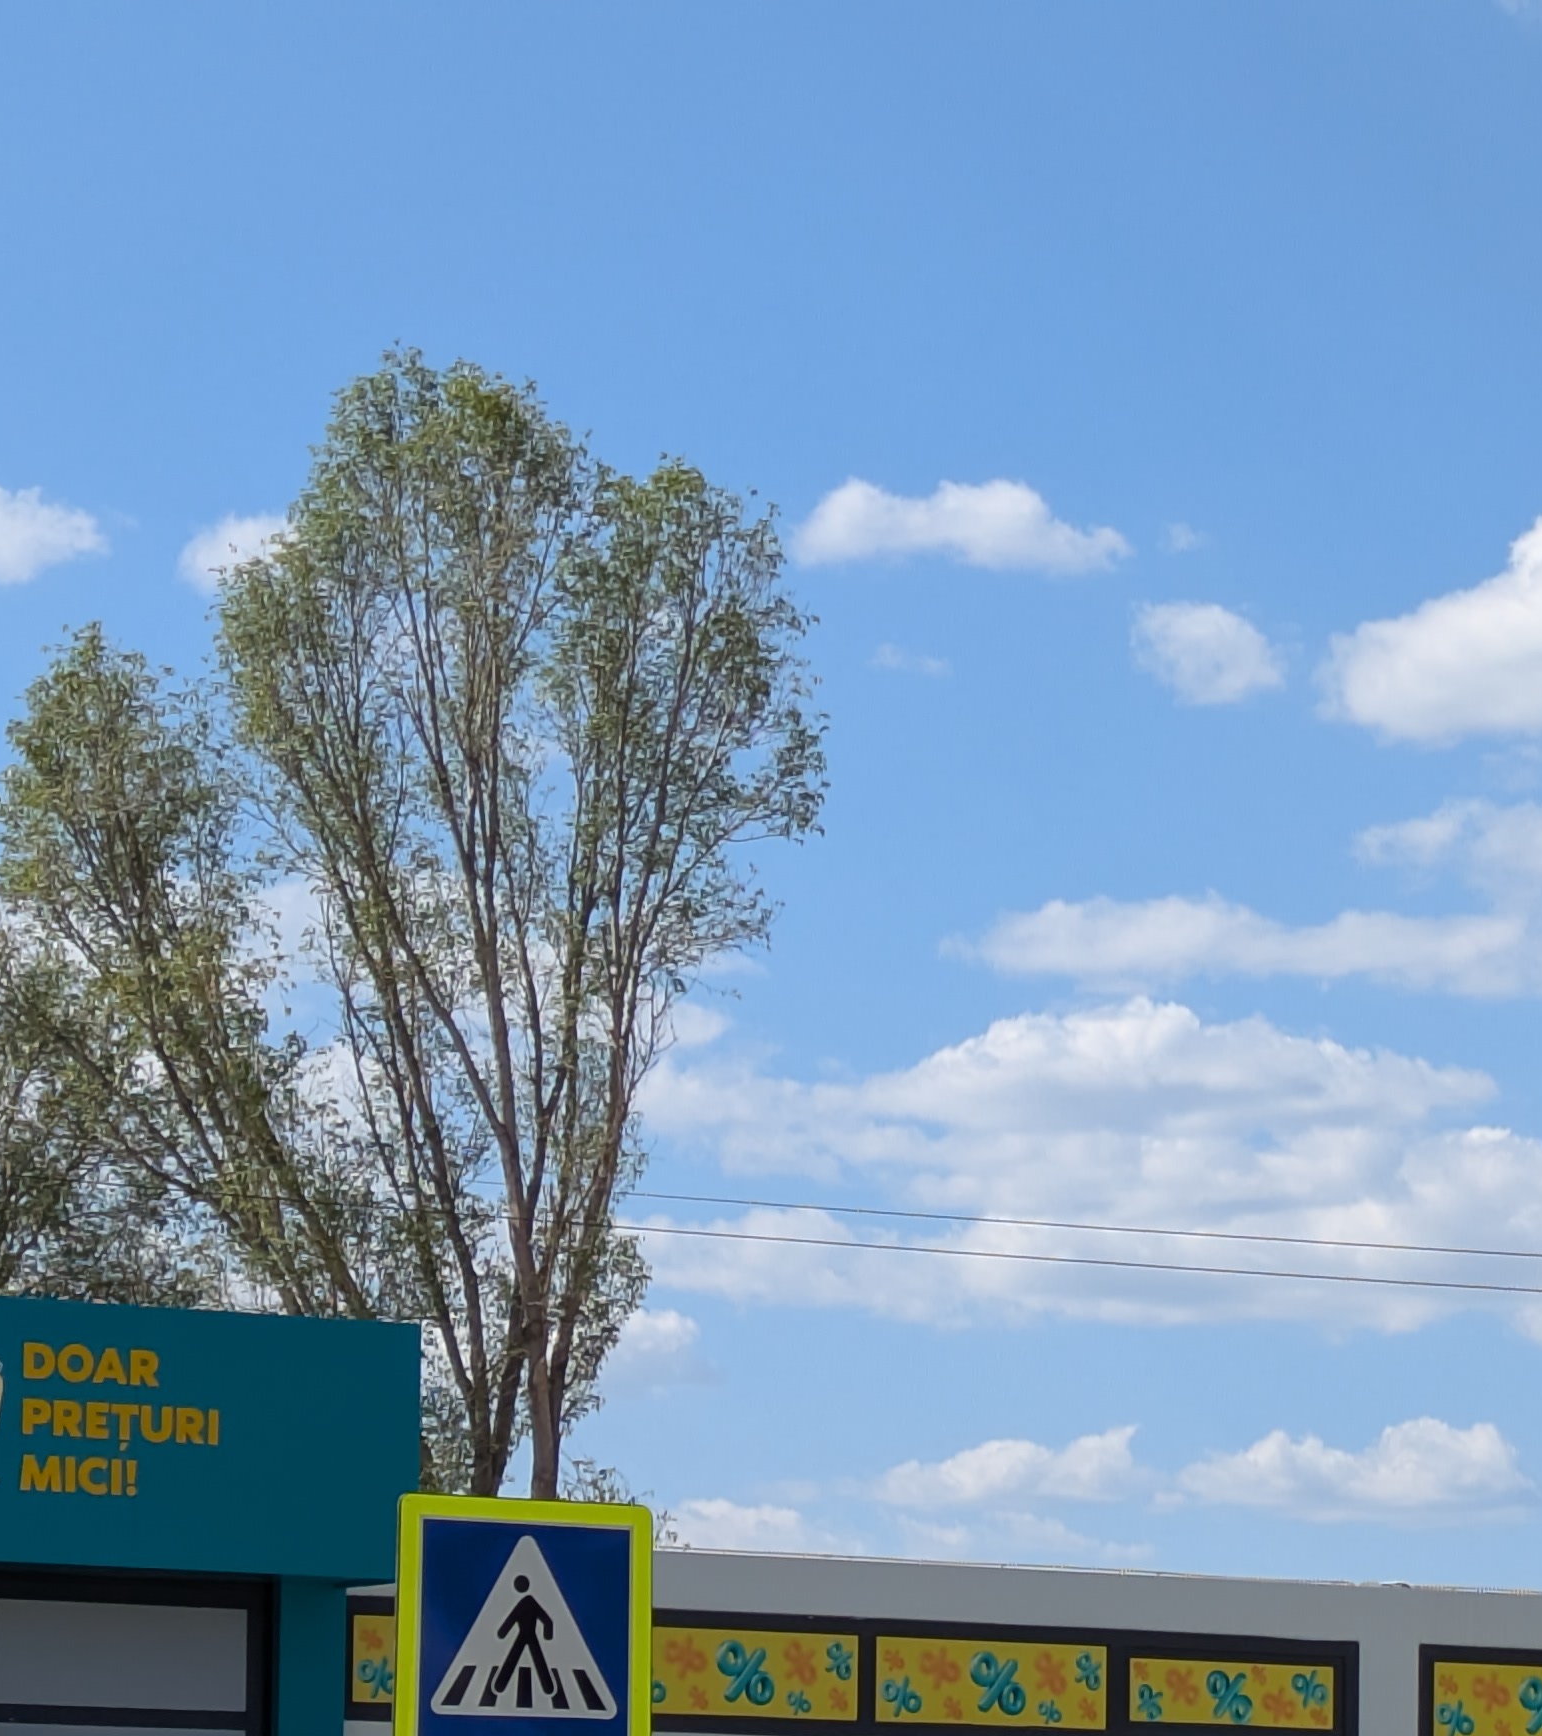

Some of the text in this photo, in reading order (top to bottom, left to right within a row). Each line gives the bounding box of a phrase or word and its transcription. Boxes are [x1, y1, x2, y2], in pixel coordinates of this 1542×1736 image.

[22, 1341, 160, 1388] DOAR
[21, 1397, 220, 1452] PREȚURI
[19, 1453, 138, 1498] MICI!
